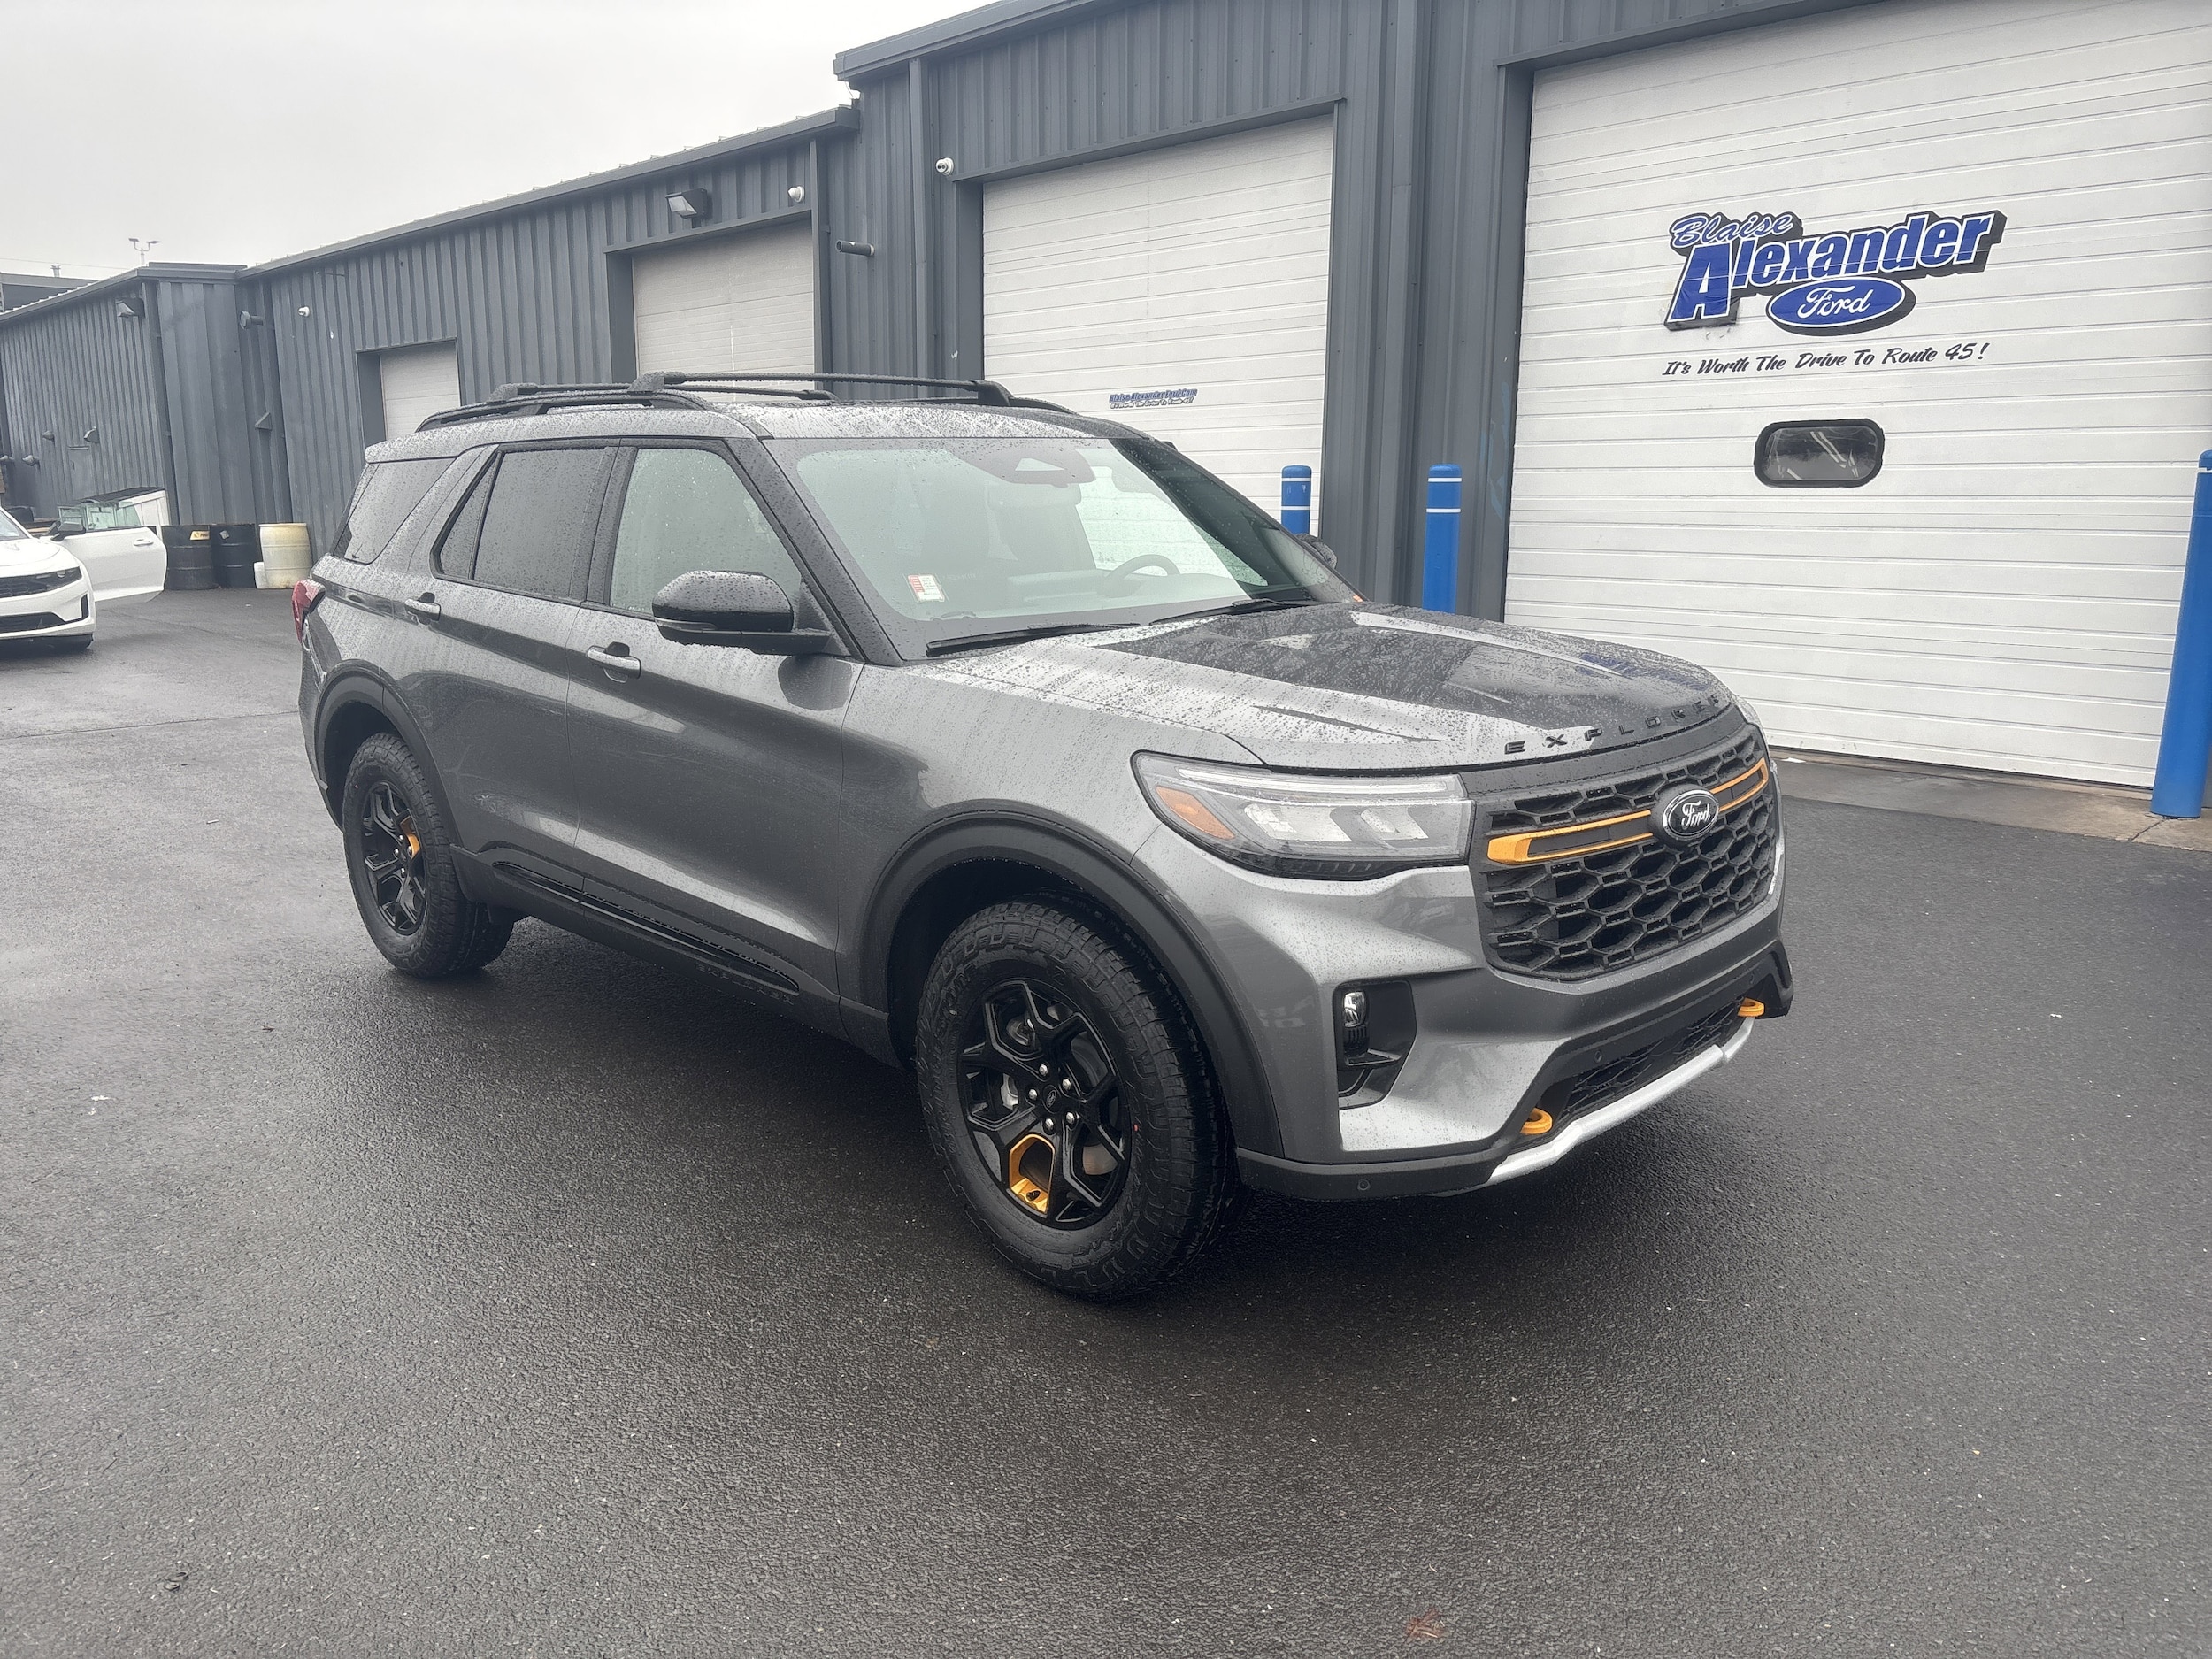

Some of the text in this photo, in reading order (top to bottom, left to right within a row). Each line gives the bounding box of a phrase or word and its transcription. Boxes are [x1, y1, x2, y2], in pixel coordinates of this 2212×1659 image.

[1671, 211, 1794, 250] Blaise
[1667, 211, 1997, 323] Alexander
[1797, 284, 1871, 319] Ford
[1662, 361, 1692, 376] It's
[1697, 356, 1749, 374] Worth
[1755, 354, 1786, 372] The
[1794, 352, 1847, 369] Drive
[1854, 349, 1875, 365] To
[1881, 347, 1938, 365] Route
[1504, 694, 1720, 755] EXPLORER
[1680, 800, 1713, 832] Ford
